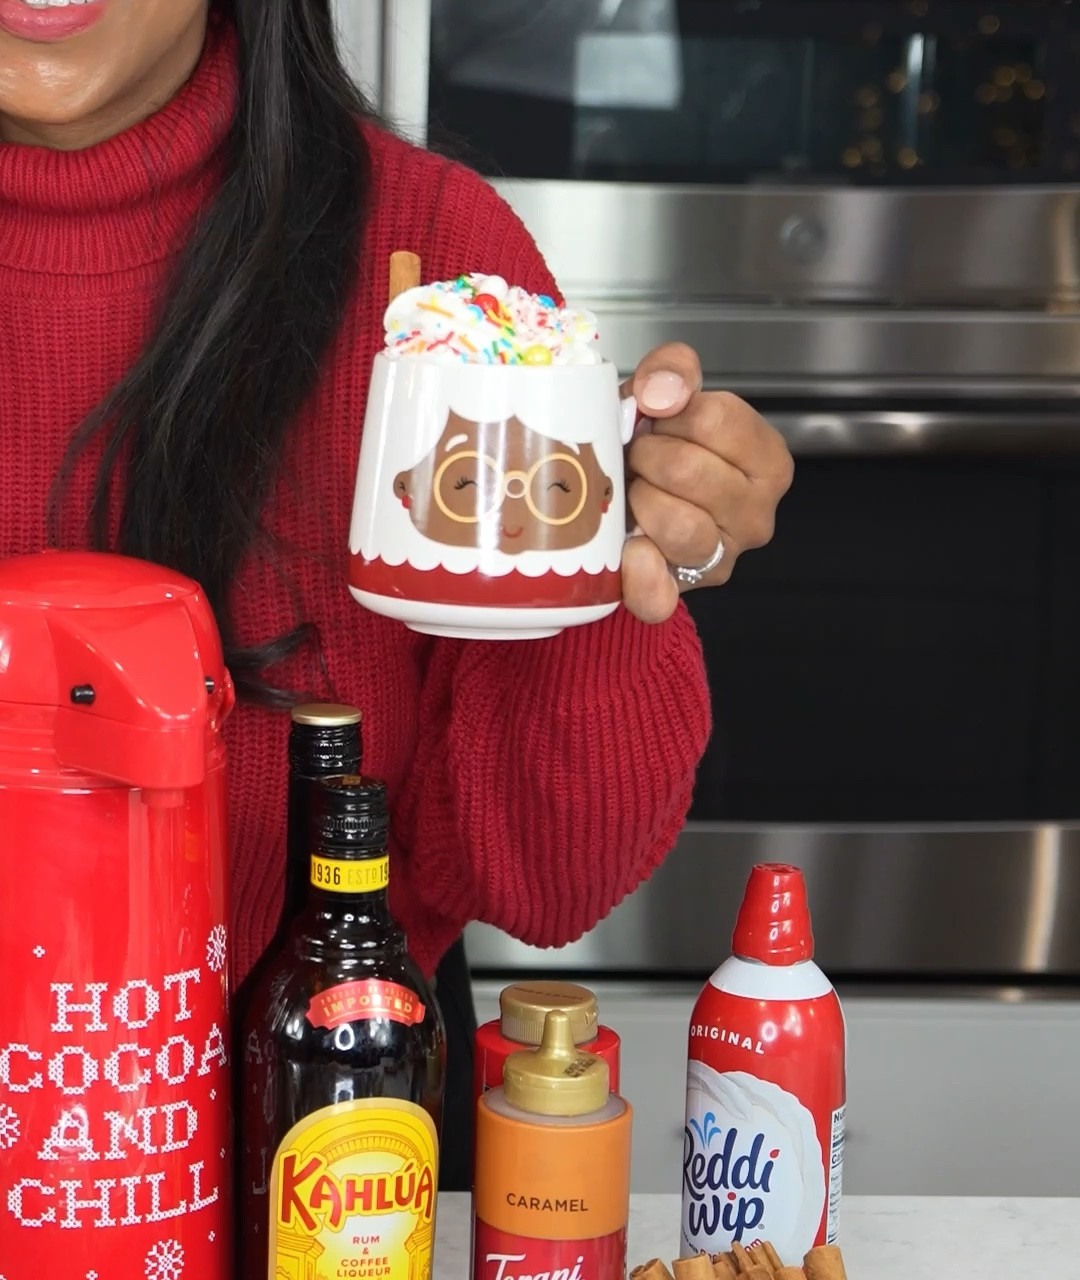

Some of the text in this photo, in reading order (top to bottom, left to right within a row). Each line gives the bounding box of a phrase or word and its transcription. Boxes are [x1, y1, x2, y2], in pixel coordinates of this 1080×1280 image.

[313, 862, 341, 886] 1936
[50, 967, 201, 1033] HOT
[690, 1024, 765, 1055] ORIGINAL
[36, 1099, 199, 1161] AND
[7, 1160, 219, 1229] CHILL
[280, 1153, 434, 1232] KAHLÚA
[506, 1192, 589, 1212] CARAMEL
[352, 1235, 381, 1245] RUM
[362, 1247, 370, 1256] &
[336, 1266, 392, 1278] LIQUEUR
[340, 1256, 389, 1267] COFFEE
